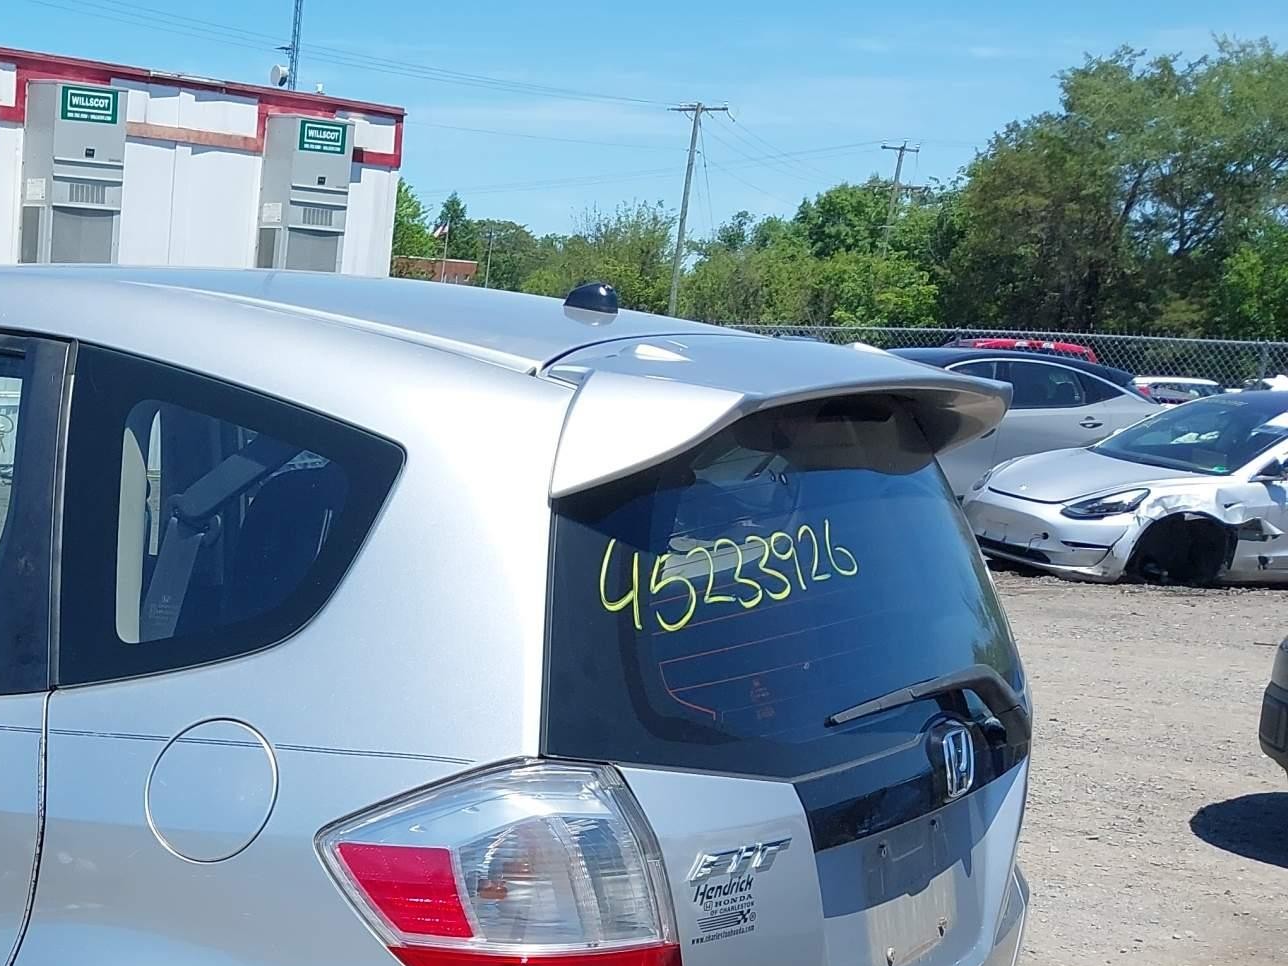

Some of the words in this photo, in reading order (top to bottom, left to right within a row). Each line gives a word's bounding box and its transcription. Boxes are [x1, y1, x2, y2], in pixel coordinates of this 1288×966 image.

[71, 95, 110, 109] WILLSCOT
[308, 129, 340, 141] WILLSCOT
[599, 519, 859, 631] 45233926
[693, 874, 754, 906] Hendrick
[714, 893, 753, 908] HONDA
[710, 909, 718, 917] OF
[719, 901, 755, 914] CHARLESTON
